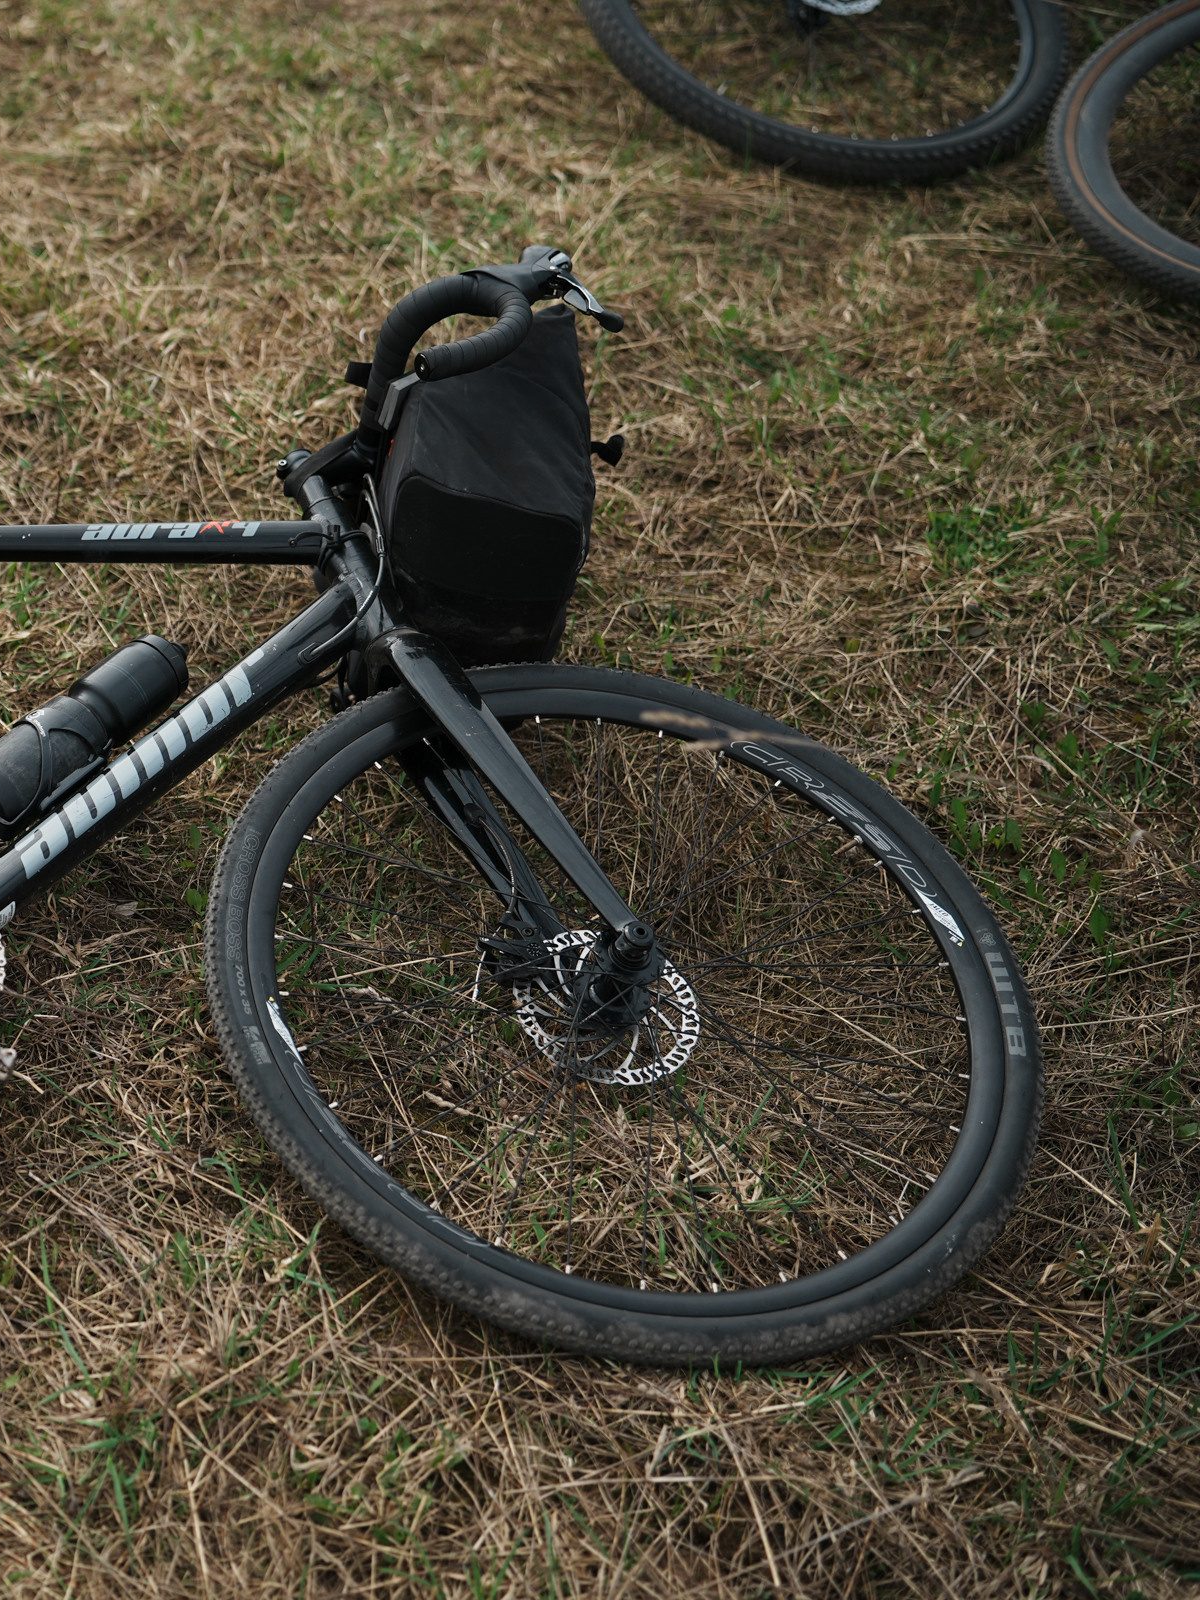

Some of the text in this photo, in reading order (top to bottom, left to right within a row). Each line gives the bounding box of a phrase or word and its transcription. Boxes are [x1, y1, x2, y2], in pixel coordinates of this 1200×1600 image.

[231, 835, 260, 901] CROSS
[226, 903, 244, 961] BOSS
[236, 964, 246, 988] 700
[984, 951, 1026, 1058] WTB
[241, 1001, 252, 1016] 35
